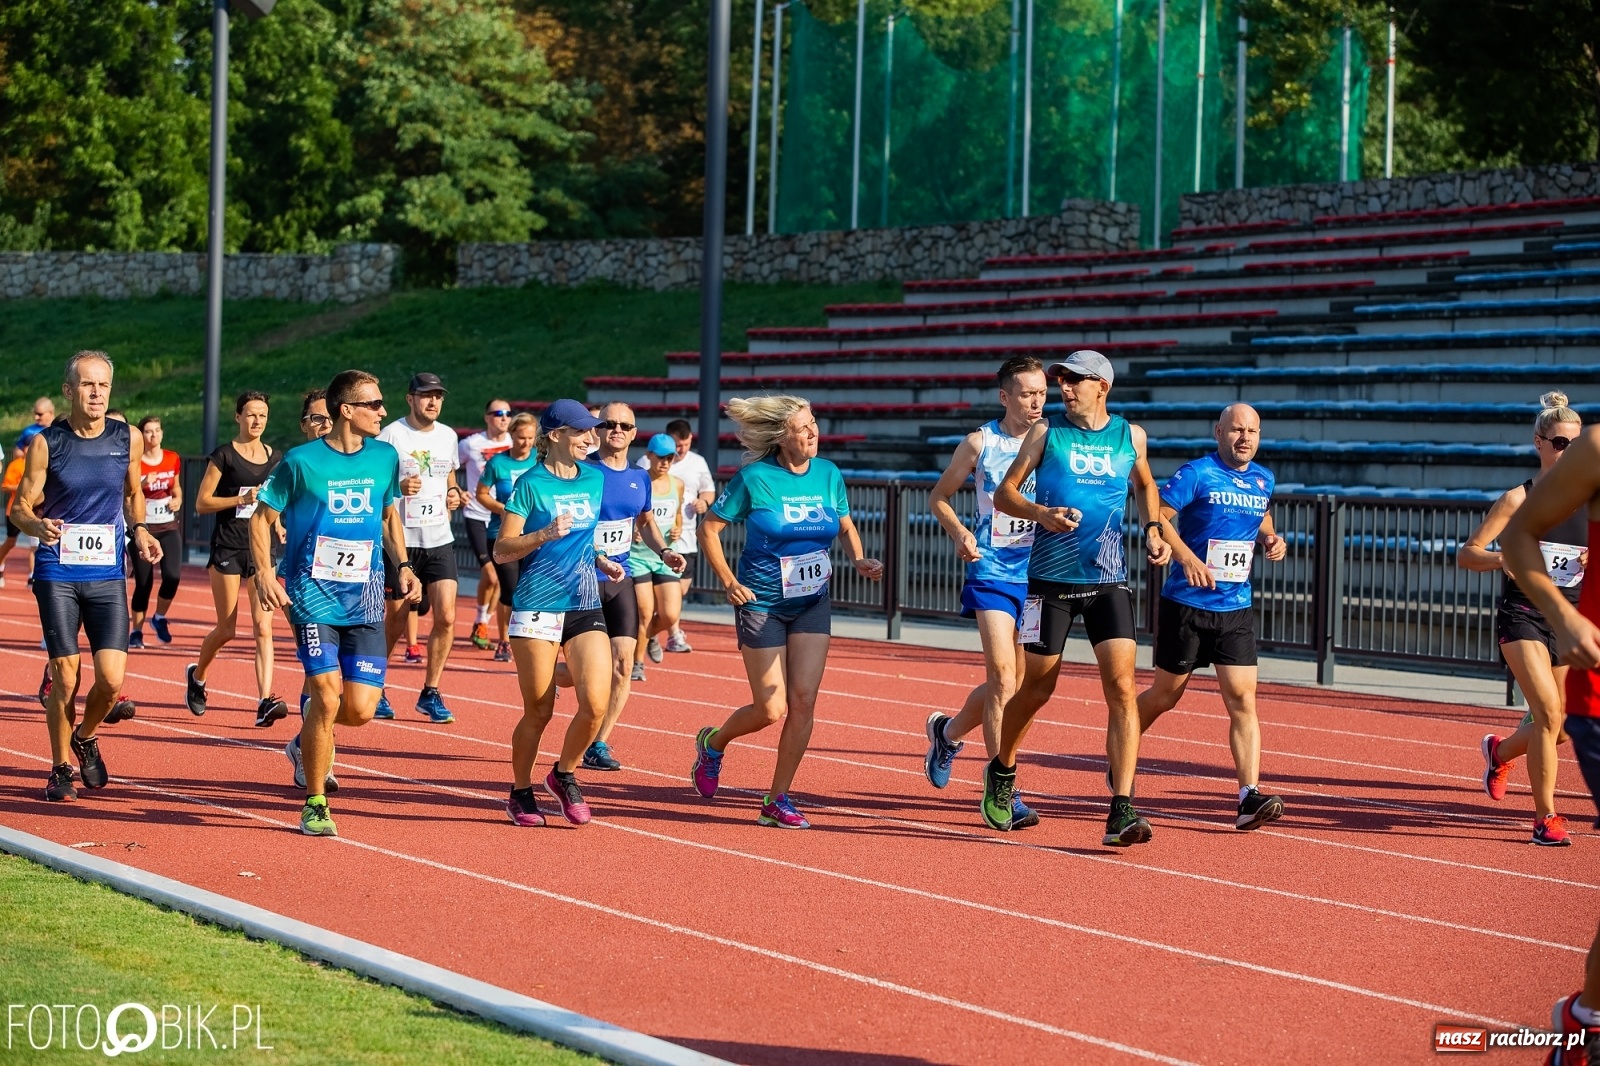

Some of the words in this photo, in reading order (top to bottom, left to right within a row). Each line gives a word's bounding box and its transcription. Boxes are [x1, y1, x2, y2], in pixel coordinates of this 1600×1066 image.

[1070, 450, 1116, 478] bbl
[328, 488, 374, 515] bbl
[421, 504, 433, 515] 73
[783, 503, 833, 523] bbl
[1009, 520, 1034, 534] 133
[78, 536, 103, 550] 106
[603, 530, 624, 543] 157
[337, 552, 355, 567] 72
[1224, 552, 1246, 567] 154
[1552, 556, 1569, 571] 52
[799, 564, 822, 581] 118
